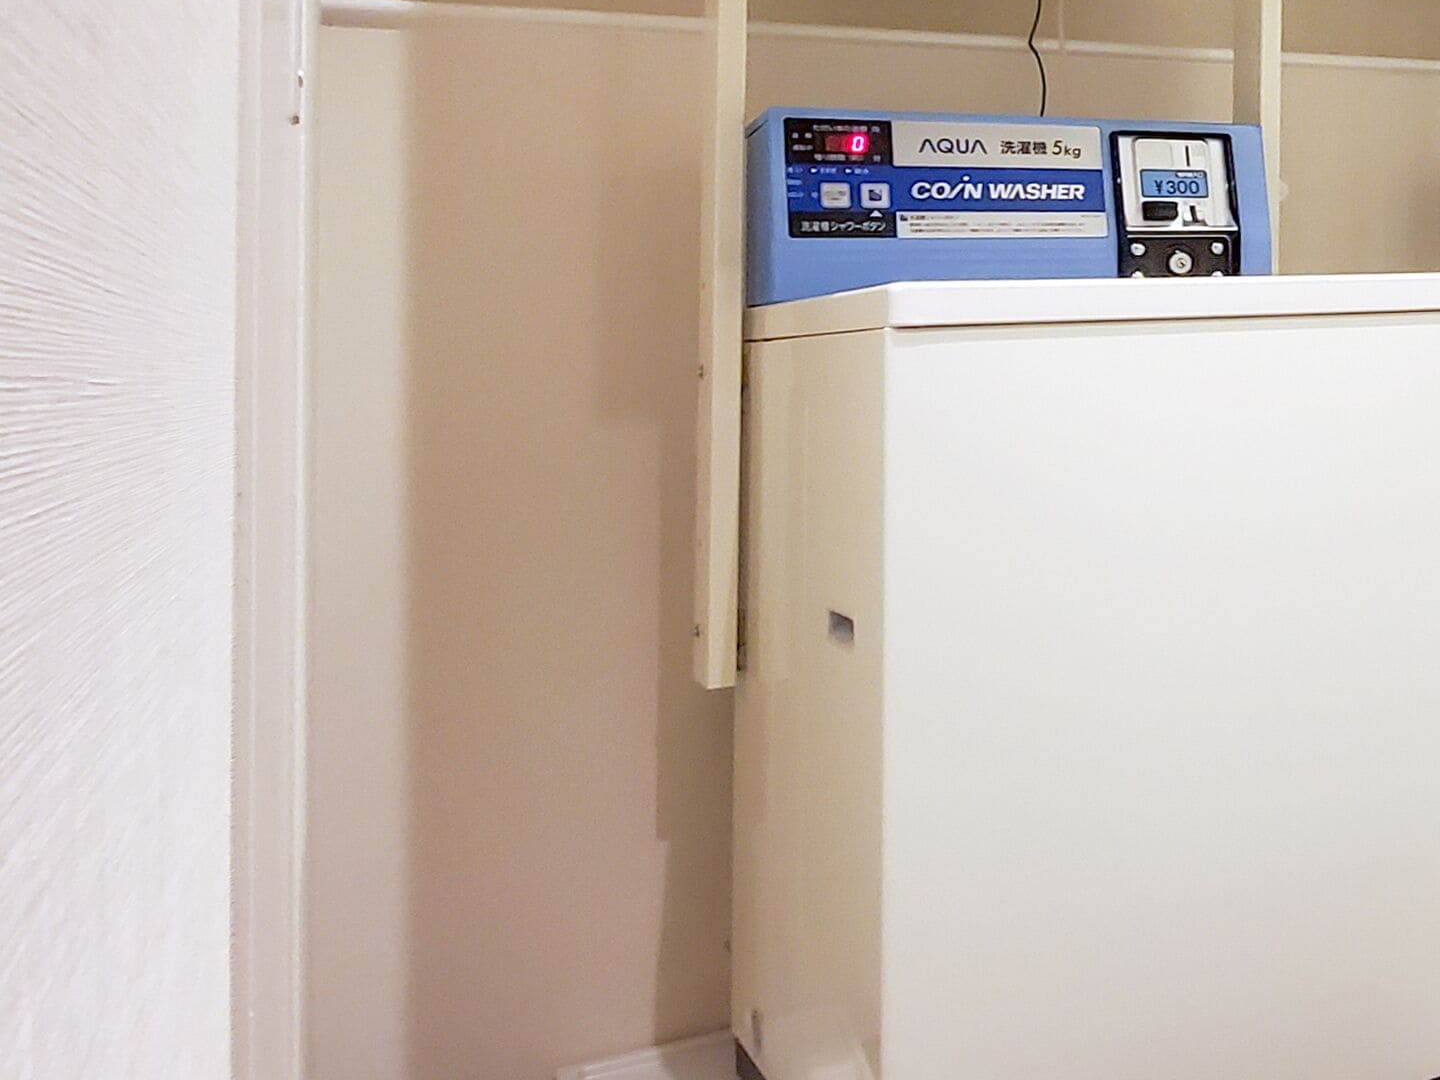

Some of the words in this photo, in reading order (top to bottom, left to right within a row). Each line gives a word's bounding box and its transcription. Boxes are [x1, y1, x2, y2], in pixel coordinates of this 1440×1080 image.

[851, 136, 864, 152] 0
[919, 139, 988, 155] AQUA
[1000, 140, 1048, 156] 洗濯機
[1052, 140, 1082, 159] 5kg
[911, 176, 983, 200] COIN
[986, 183, 1086, 201] WASHER
[1154, 180, 1200, 195] ¥300
